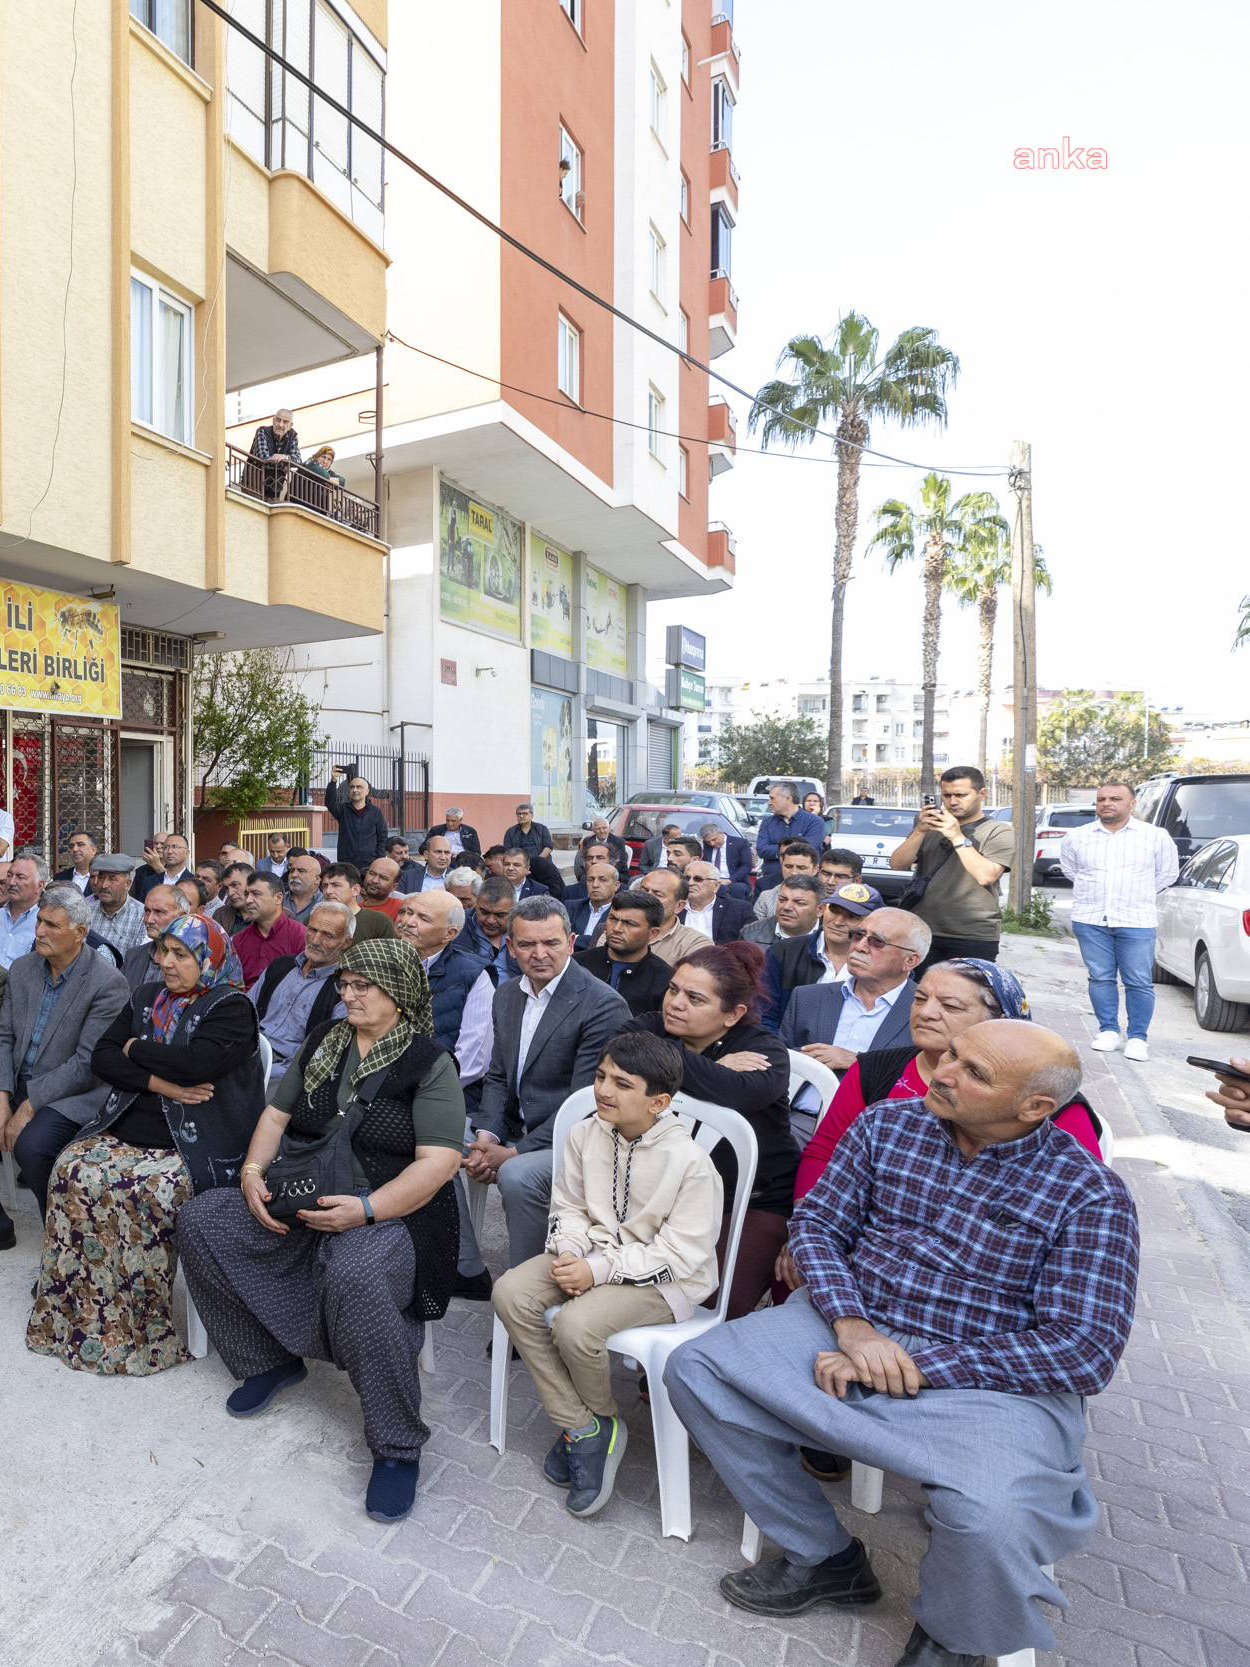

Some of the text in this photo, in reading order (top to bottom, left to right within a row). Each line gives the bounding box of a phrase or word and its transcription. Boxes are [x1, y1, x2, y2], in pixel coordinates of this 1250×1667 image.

[470, 510, 492, 533] TARAL
[7, 596, 33, 632] İLİ
[44, 651, 105, 683] BİRLİĞİ
[6, 685, 16, 696] 66
[17, 685, 27, 697] 83
[872, 857, 879, 865] R
